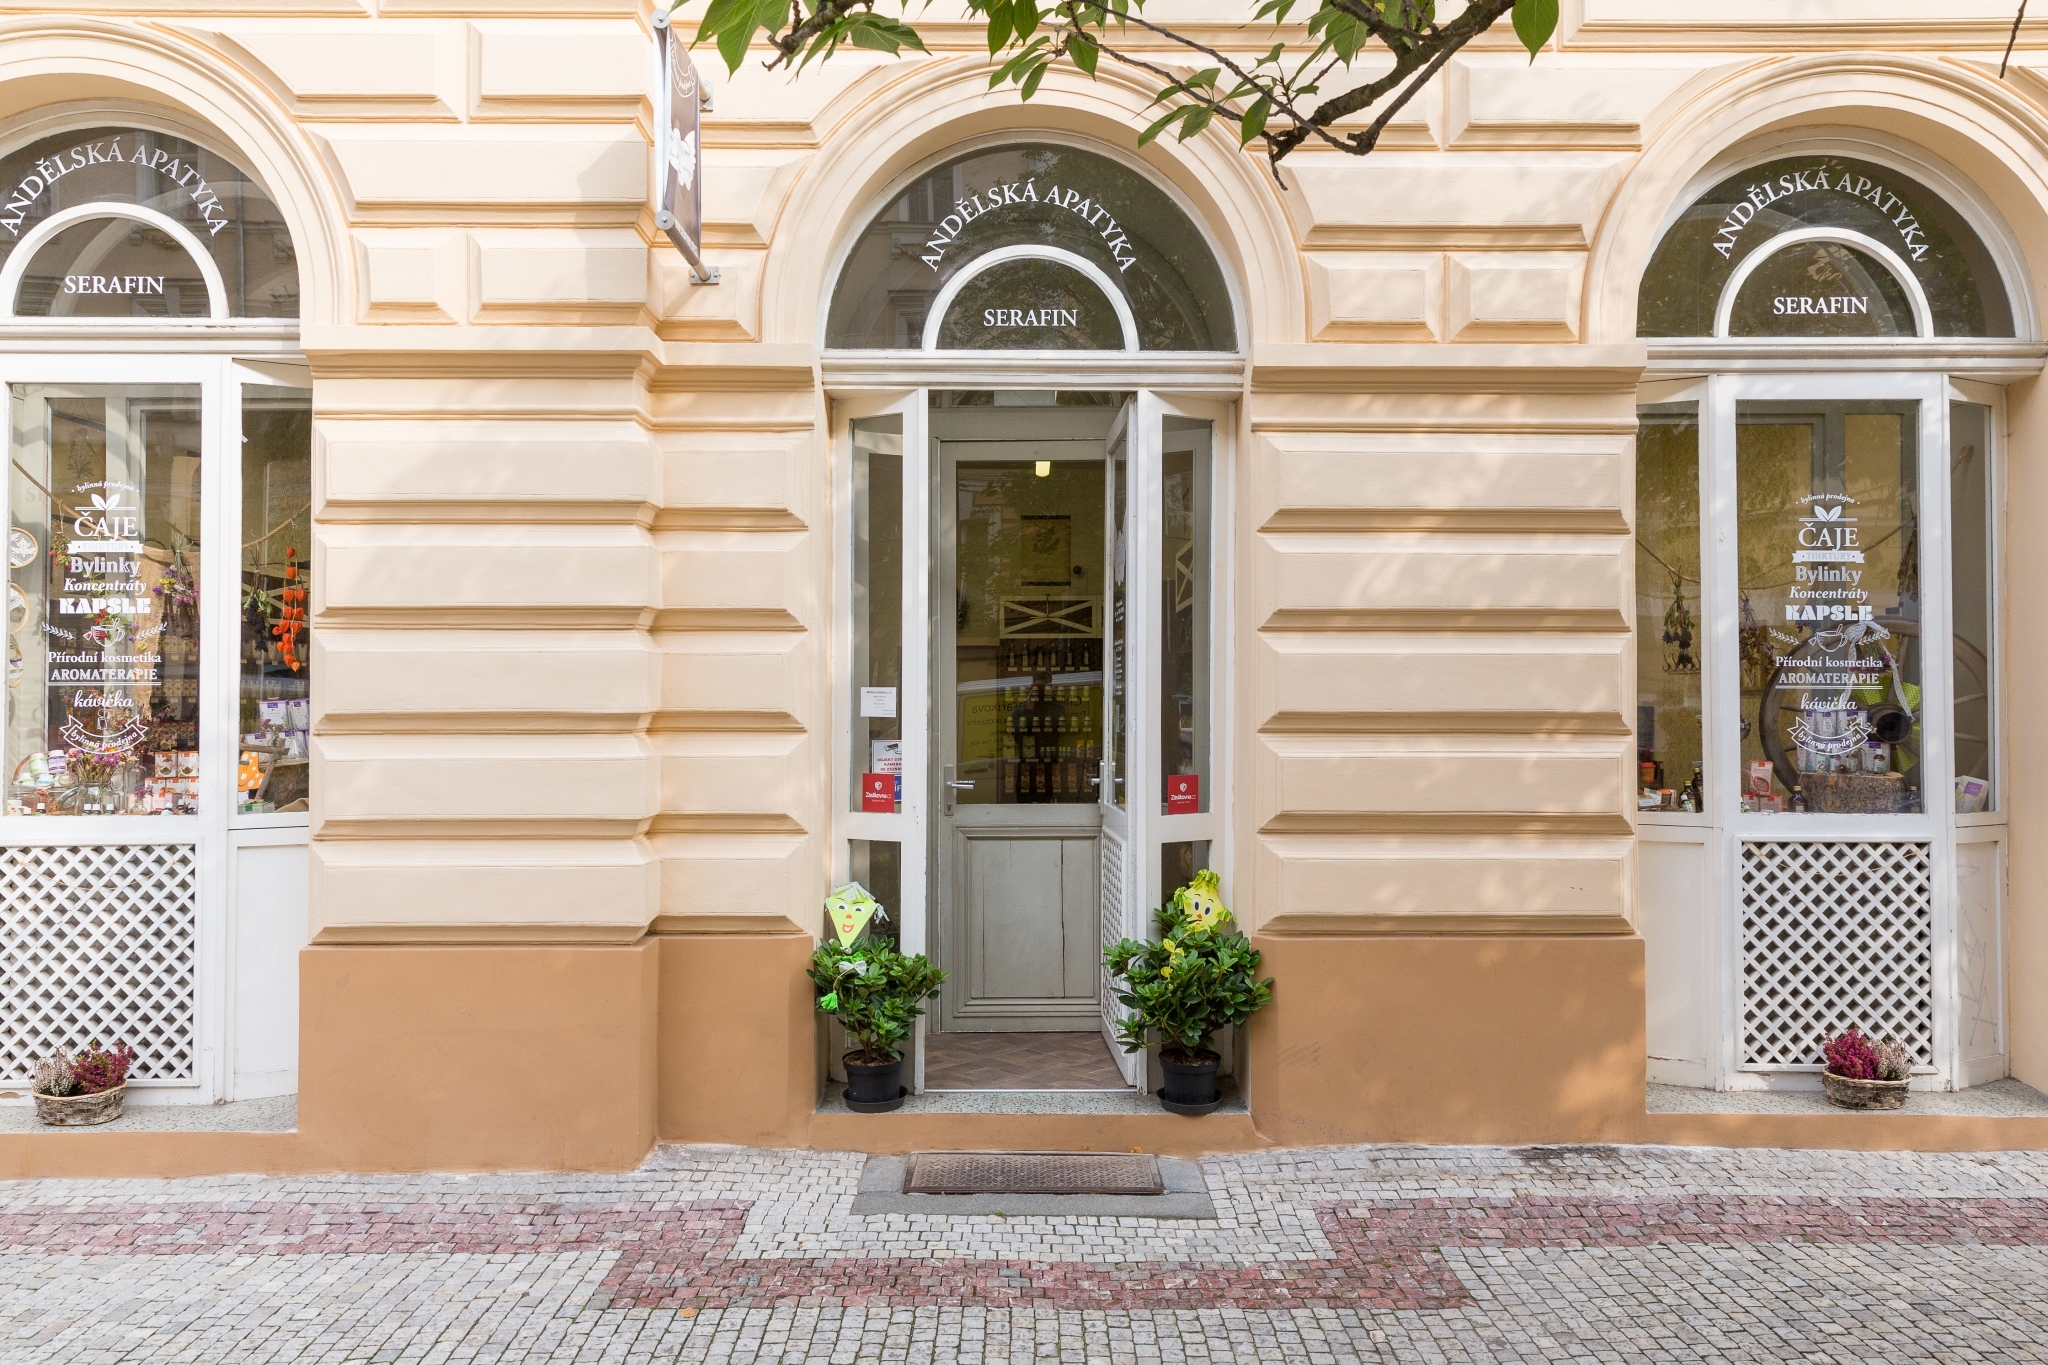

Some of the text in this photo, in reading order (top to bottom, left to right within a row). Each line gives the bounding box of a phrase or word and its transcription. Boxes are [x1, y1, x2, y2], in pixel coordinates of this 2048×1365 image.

[0, 137, 229, 237] ANDĚLSKÁ APATYKA
[1712, 165, 1930, 261] ANDĚLSKÁ APATYKA
[921, 177, 1137, 273] ANDĚLSKÁ APATYKA
[64, 275, 165, 295] SERAFIN
[1773, 296, 1868, 315] SERAFIN
[983, 309, 1078, 327] SERAFIN
[1800, 493, 1855, 505] bylinná prodejna
[74, 510, 138, 541] ČAJE
[1798, 522, 1859, 551] ČAJE
[82, 542, 130, 551] TINKTURY
[1806, 552, 1851, 560] TINKTURY
[70, 557, 141, 578] Bylinky
[1795, 565, 1862, 586] Bylinky
[63, 578, 147, 595] Koncentráty
[1789, 585, 1868, 603] Koncentráty
[59, 598, 151, 614] KAPSLE
[1785, 604, 1873, 621] KAPSLE
[48, 651, 162, 663] Přírodní kosmetika
[1775, 656, 1883, 668] Přírodní kosmetika
[51, 668, 157, 680] AROMATERAPIE
[1779, 672, 1880, 684] AROMATERAPIE
[74, 689, 135, 708] kávička
[1800, 692, 1857, 710] kávička
[70, 730, 138, 750] bylinná prodejna
[1798, 731, 1861, 752] bylinná prodejna
